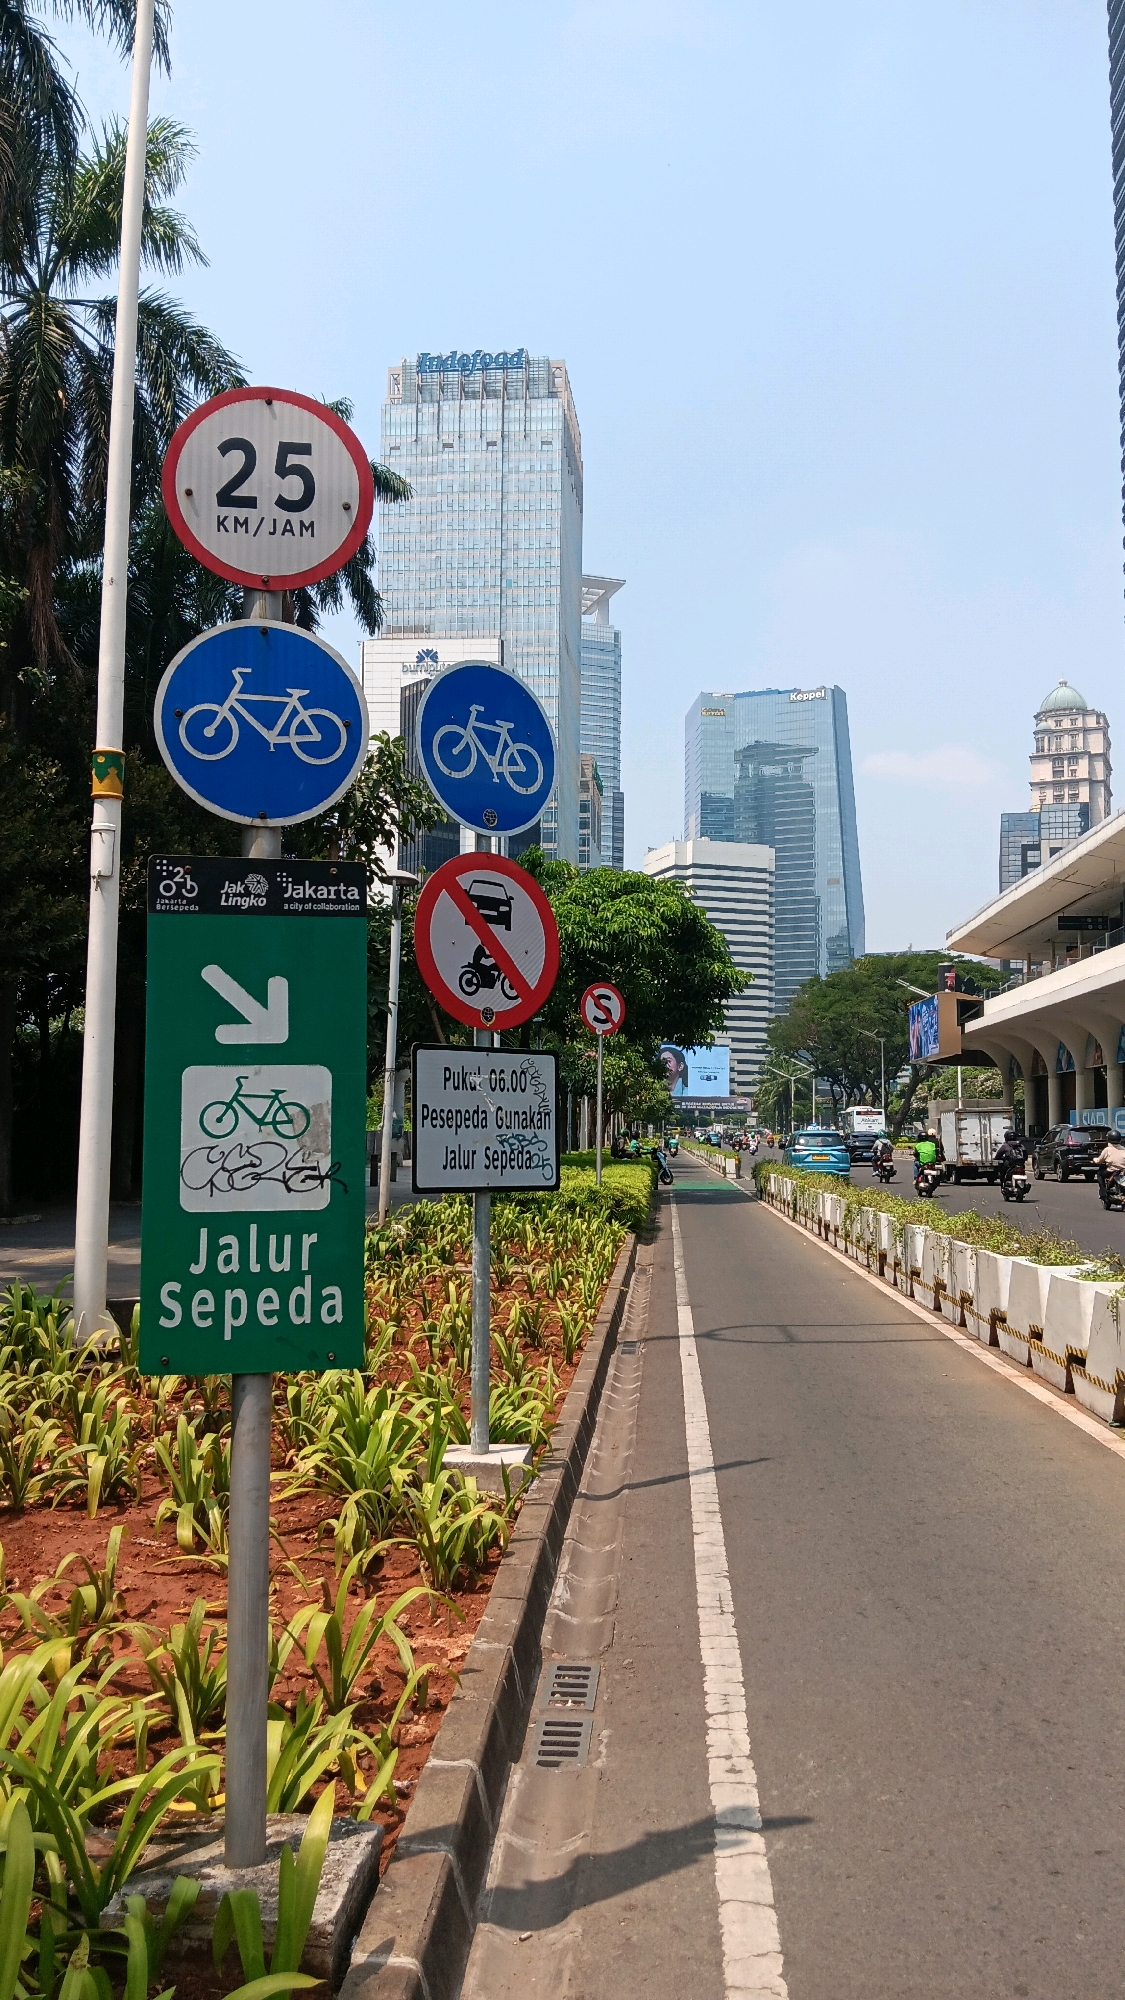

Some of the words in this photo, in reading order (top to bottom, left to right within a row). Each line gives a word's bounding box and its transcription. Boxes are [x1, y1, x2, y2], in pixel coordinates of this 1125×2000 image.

[418, 348, 525, 377] Indofood
[216, 437, 316, 513] 25
[216, 515, 316, 538] KM/JAM
[220, 880, 246, 894] Jak
[220, 894, 267, 910] Lingko
[289, 903, 303, 912] city
[312, 903, 360, 911] collaboration
[489, 1068, 527, 1093] 06.00
[421, 1103, 488, 1135] Pesepeda
[495, 1105, 551, 1130] Gunakan
[442, 1144, 477, 1170] Jalur
[484, 1145, 532, 1176] Sepeda
[189, 1223, 318, 1275] Jalur
[158, 1274, 344, 1341] Sepeda
